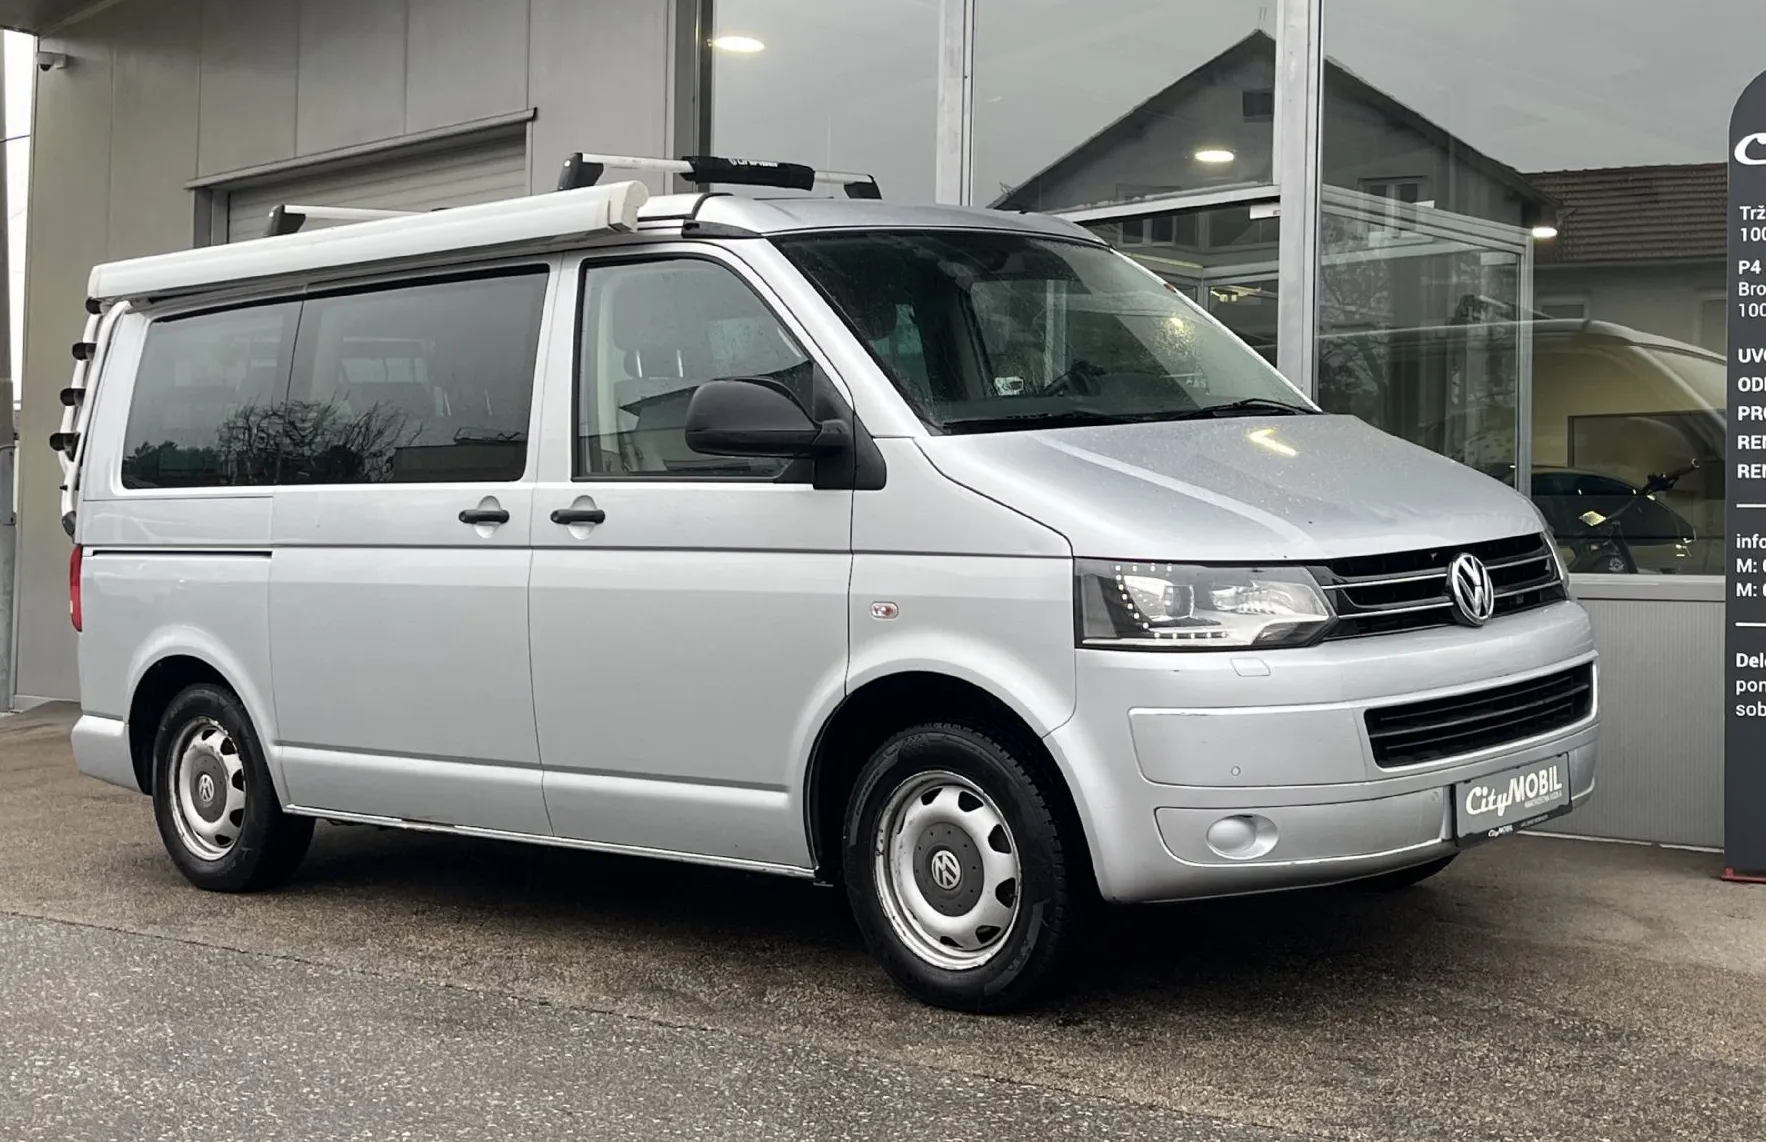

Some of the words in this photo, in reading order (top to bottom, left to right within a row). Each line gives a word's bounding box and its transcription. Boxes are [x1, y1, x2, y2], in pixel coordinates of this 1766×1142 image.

[1738, 260, 1761, 275] P4
[1738, 282, 1766, 297] Bro
[1738, 348, 1766, 363] UV
[1737, 377, 1766, 392] OD
[1738, 406, 1766, 421] PR
[1736, 534, 1766, 549] info
[1736, 558, 1758, 573] M:
[1736, 582, 1758, 597] M:
[1735, 701, 1766, 717] sob
[1465, 765, 1562, 817] CityMOBIL
